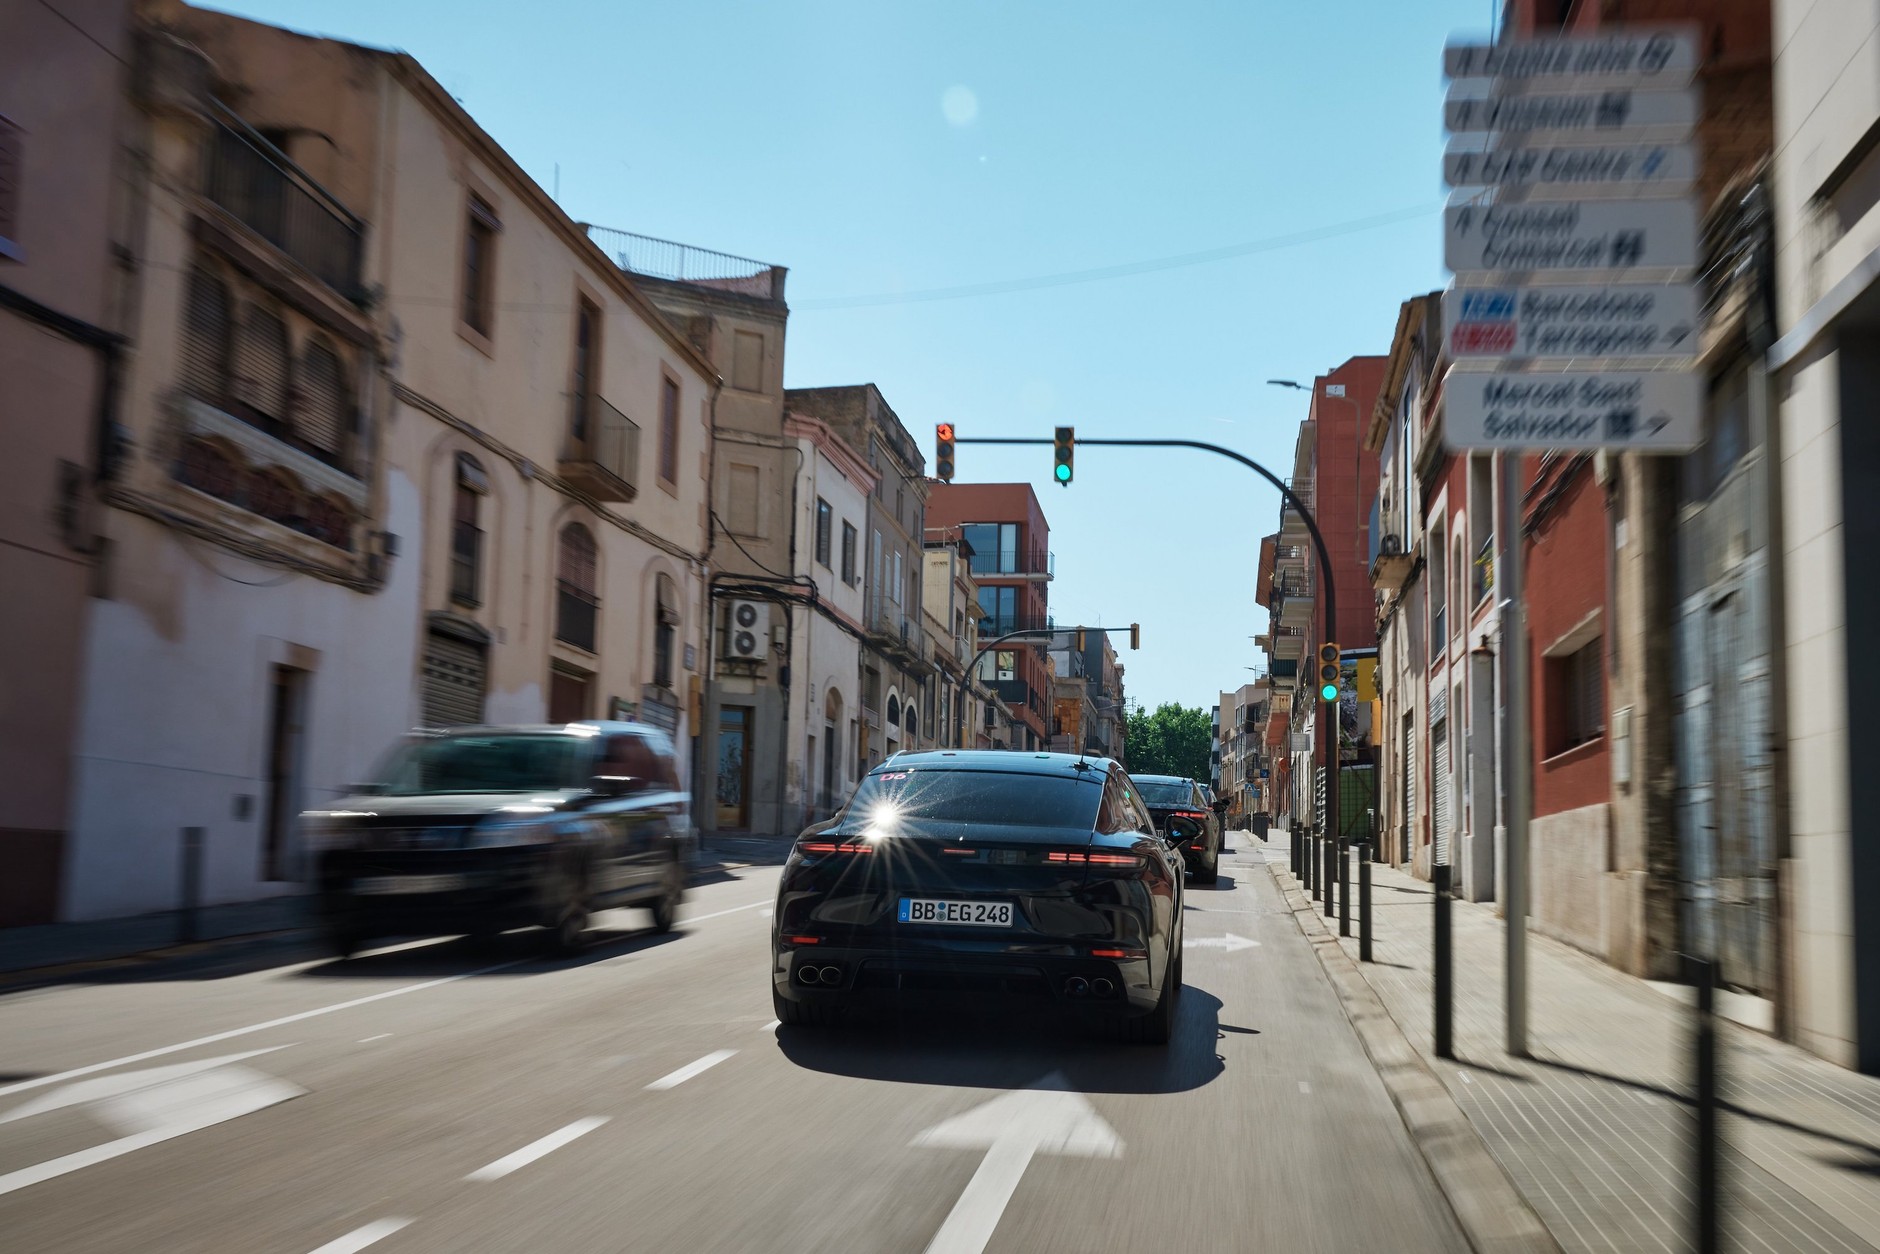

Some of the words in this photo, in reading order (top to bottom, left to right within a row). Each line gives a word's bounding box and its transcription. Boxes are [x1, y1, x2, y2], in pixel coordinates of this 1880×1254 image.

[1520, 290, 1654, 322] Barcelona
[1521, 323, 1658, 356] Tarragona
[1483, 378, 1577, 409] Mercat
[1579, 376, 1641, 407] Sant
[1483, 408, 1600, 440] Salvador
[881, 773, 906, 781] D6
[912, 902, 935, 920] BB
[947, 904, 971, 921] EG
[975, 905, 1009, 923] 248
